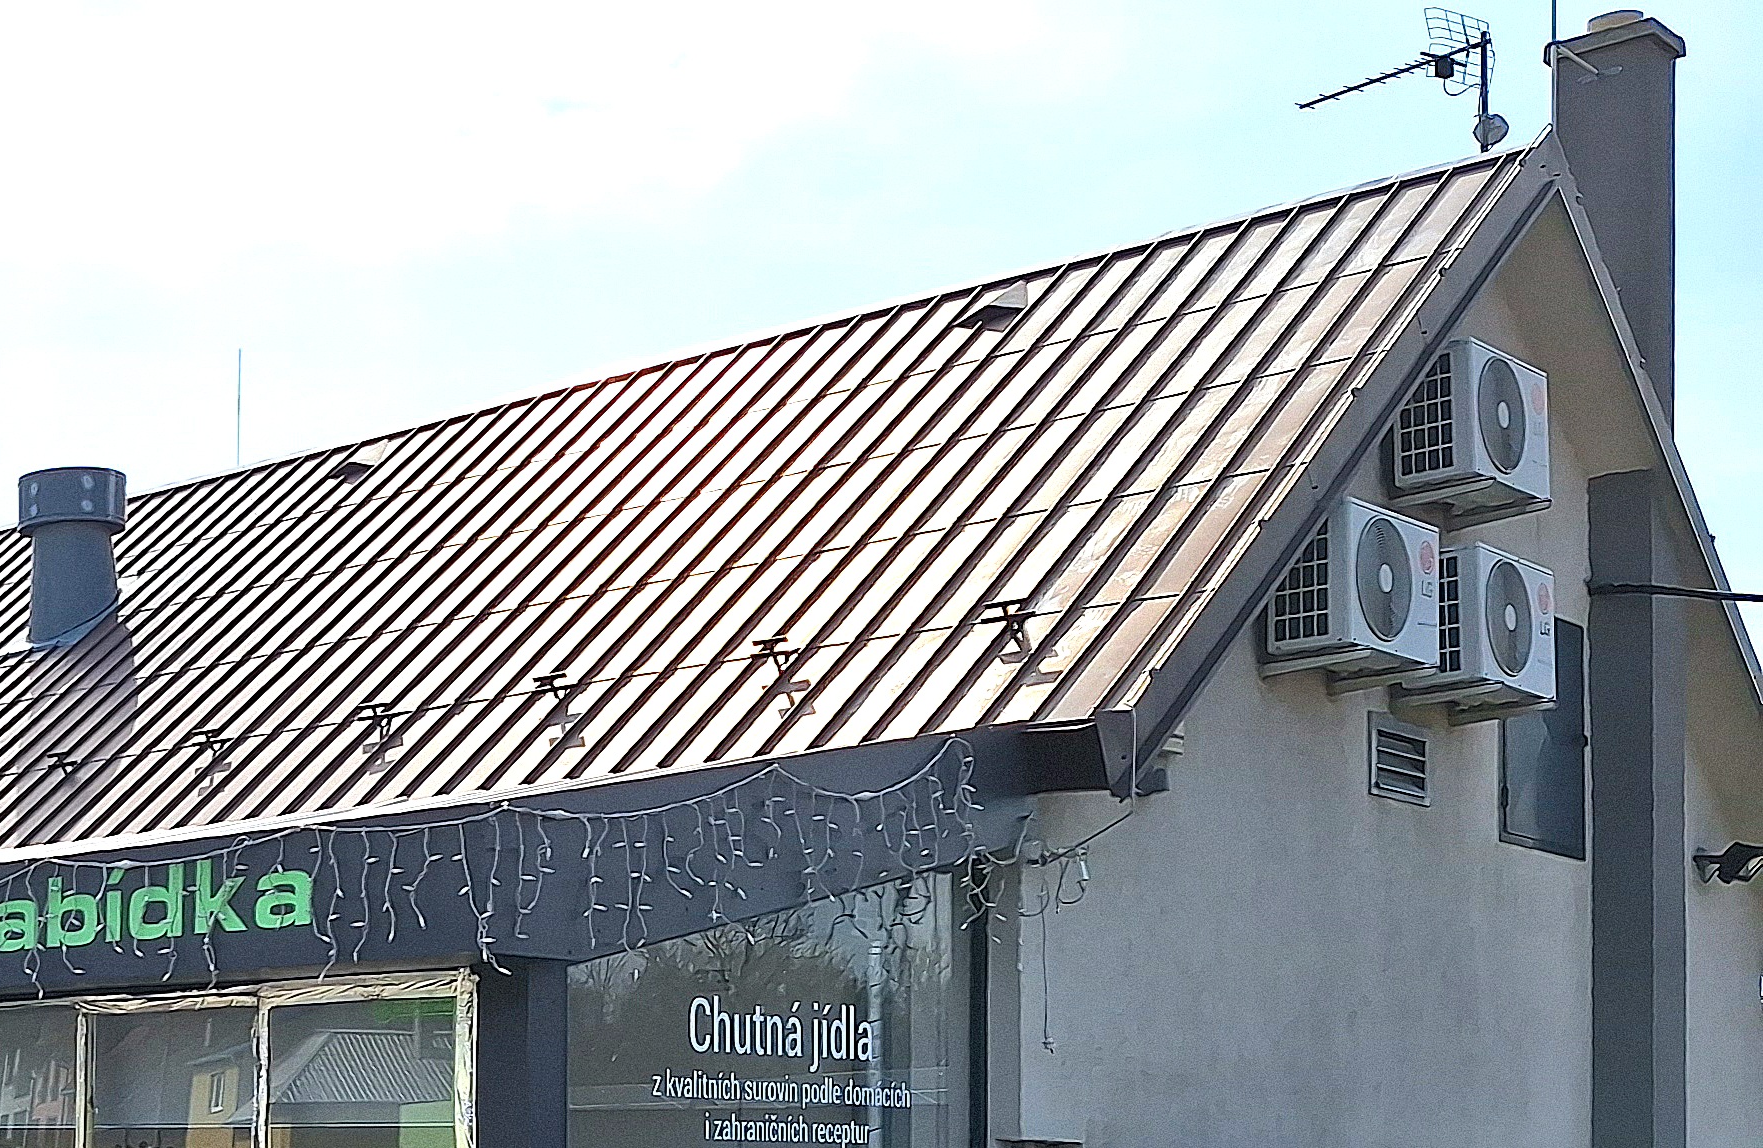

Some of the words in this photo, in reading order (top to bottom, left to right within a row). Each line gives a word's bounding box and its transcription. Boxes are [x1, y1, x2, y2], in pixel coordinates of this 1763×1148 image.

[689, 994, 803, 1058] Chutná
[809, 1000, 873, 1073] jídla
[652, 1074, 662, 1097] z
[665, 1068, 740, 1101] kvalitních
[744, 1075, 798, 1103] surovin
[802, 1077, 842, 1110] podle
[844, 1078, 912, 1109] domácích
[704, 1111, 711, 1141] i
[714, 1112, 809, 1144] zahraničních
